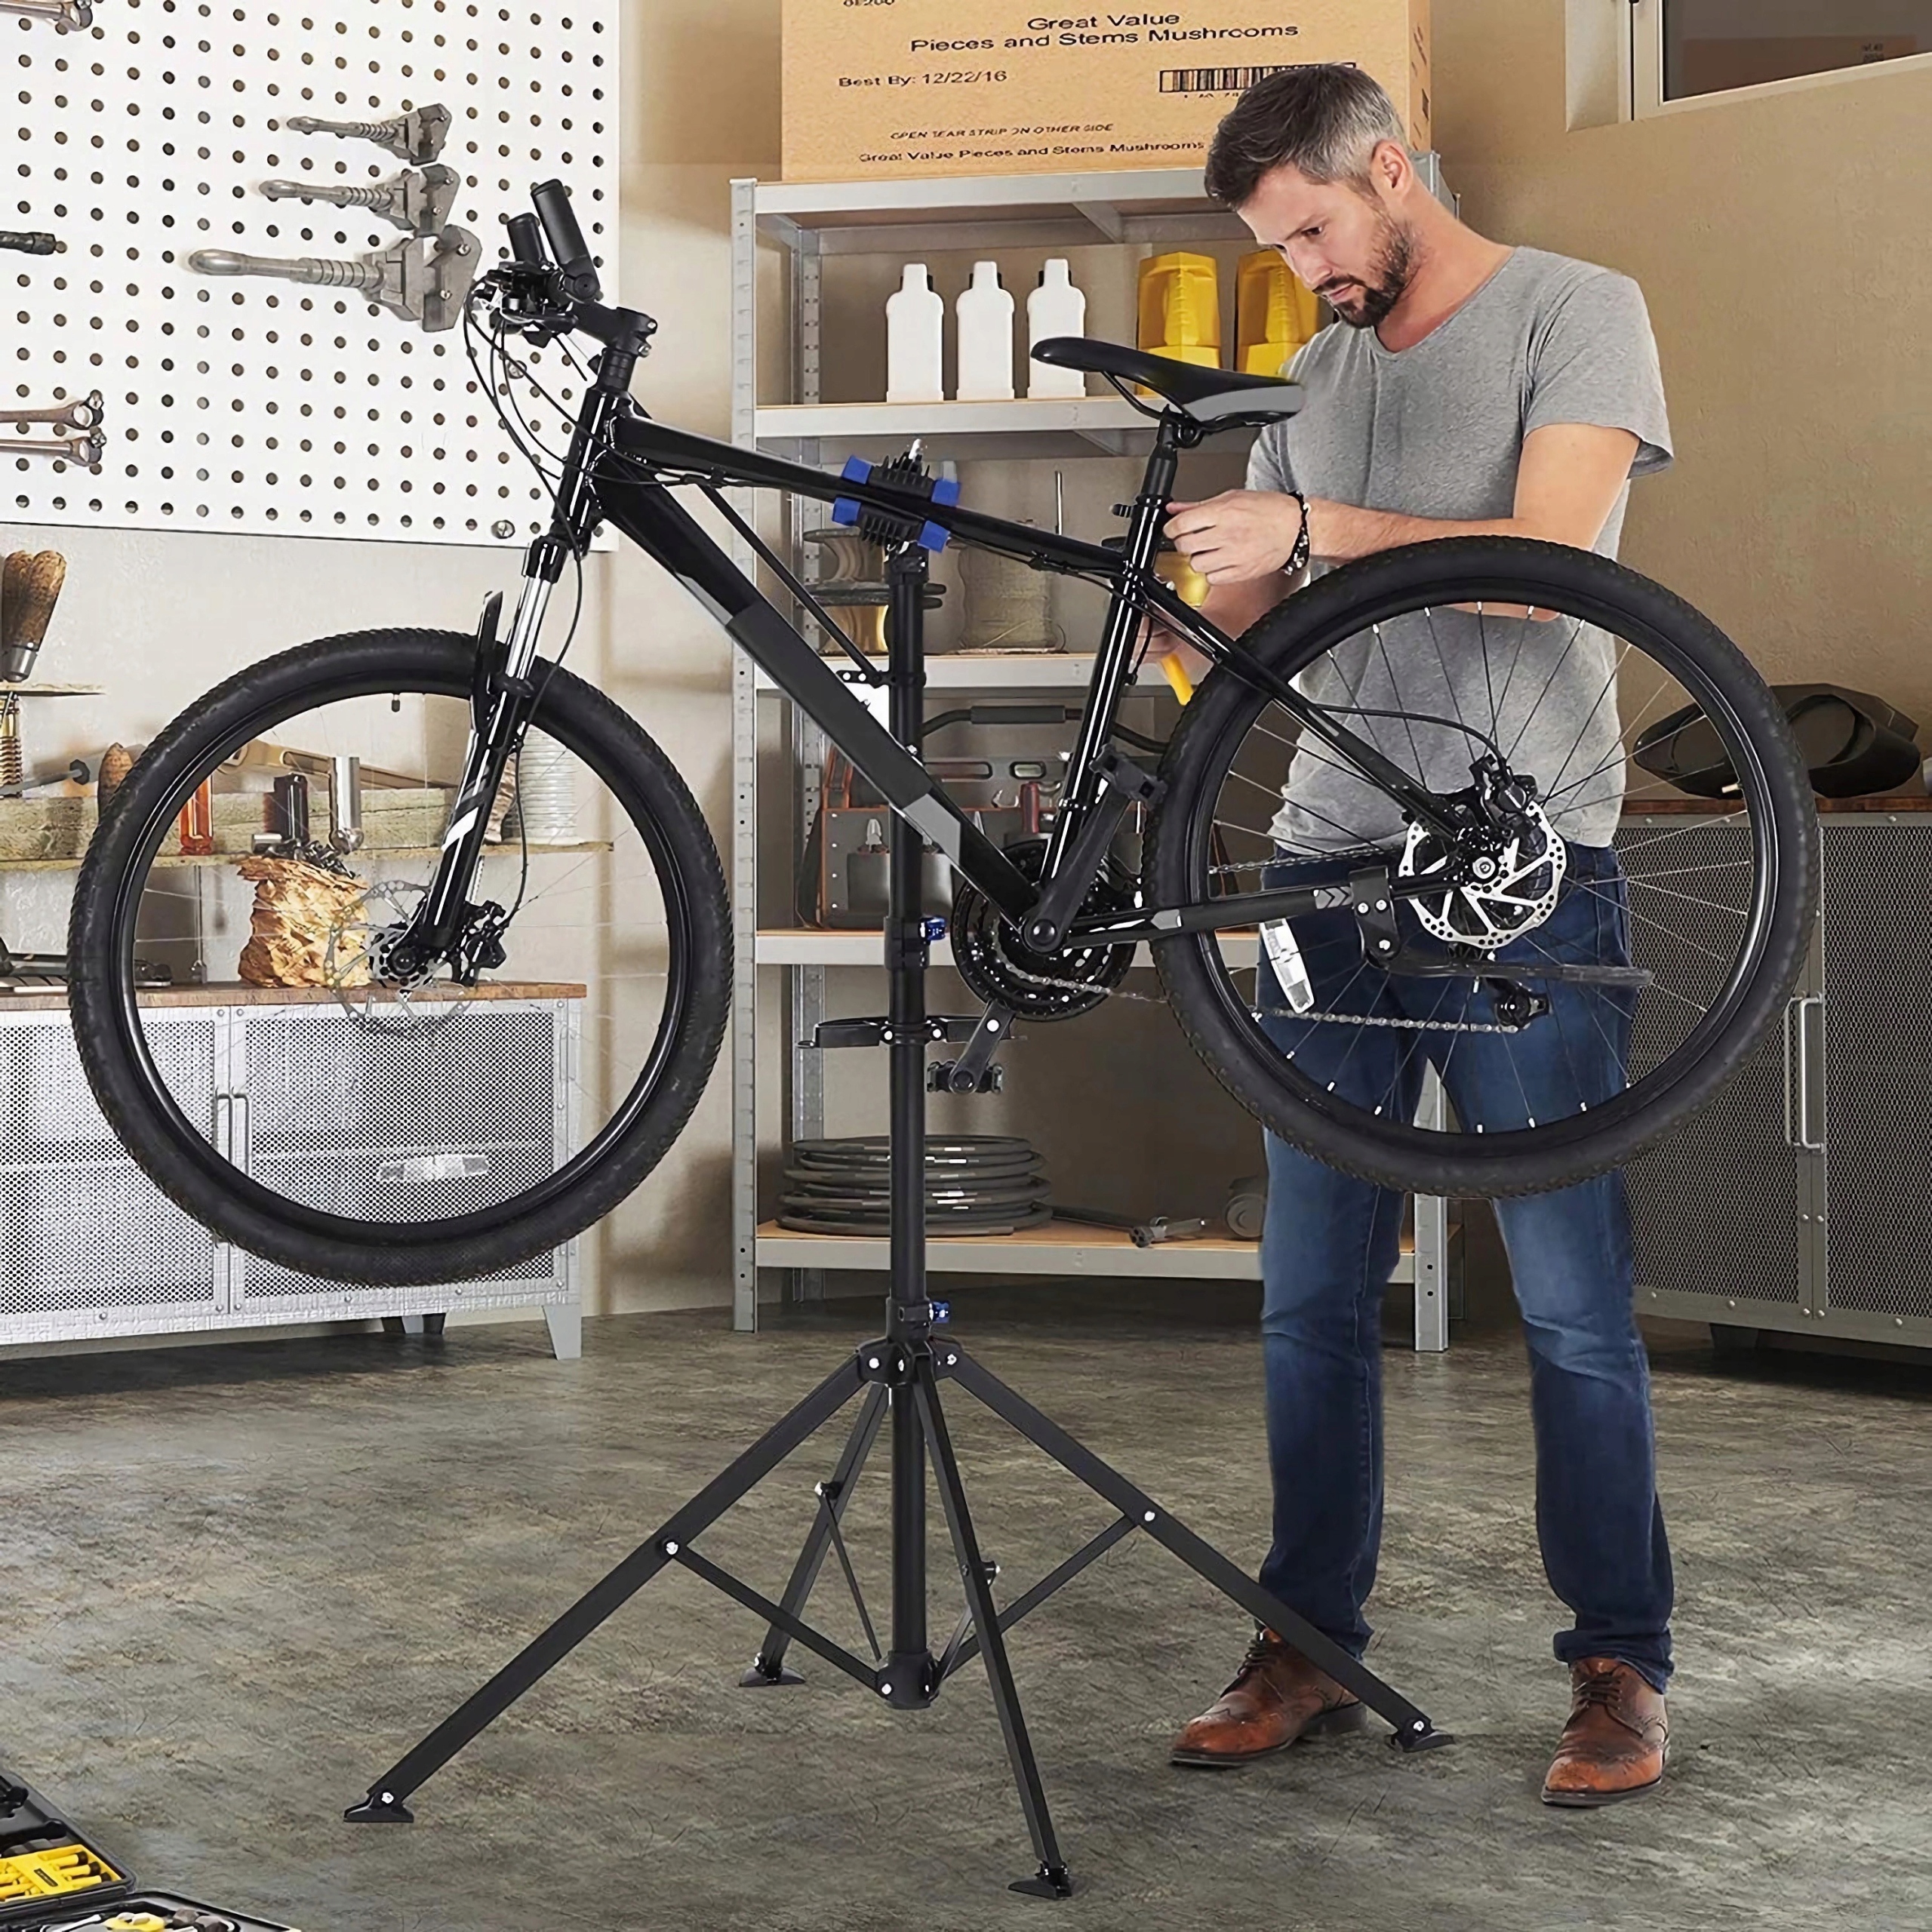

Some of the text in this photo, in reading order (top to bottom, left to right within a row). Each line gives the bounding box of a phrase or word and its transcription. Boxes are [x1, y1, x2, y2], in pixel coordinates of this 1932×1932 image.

[1027, 14, 1180, 31] Great Value
[911, 25, 1299, 52] Pieces and Stems Mushrooms
[838, 70, 1008, 88] Best By: 12/22/16
[1017, 147, 1048, 156] and
[1109, 142, 1205, 153] Mushrooms
